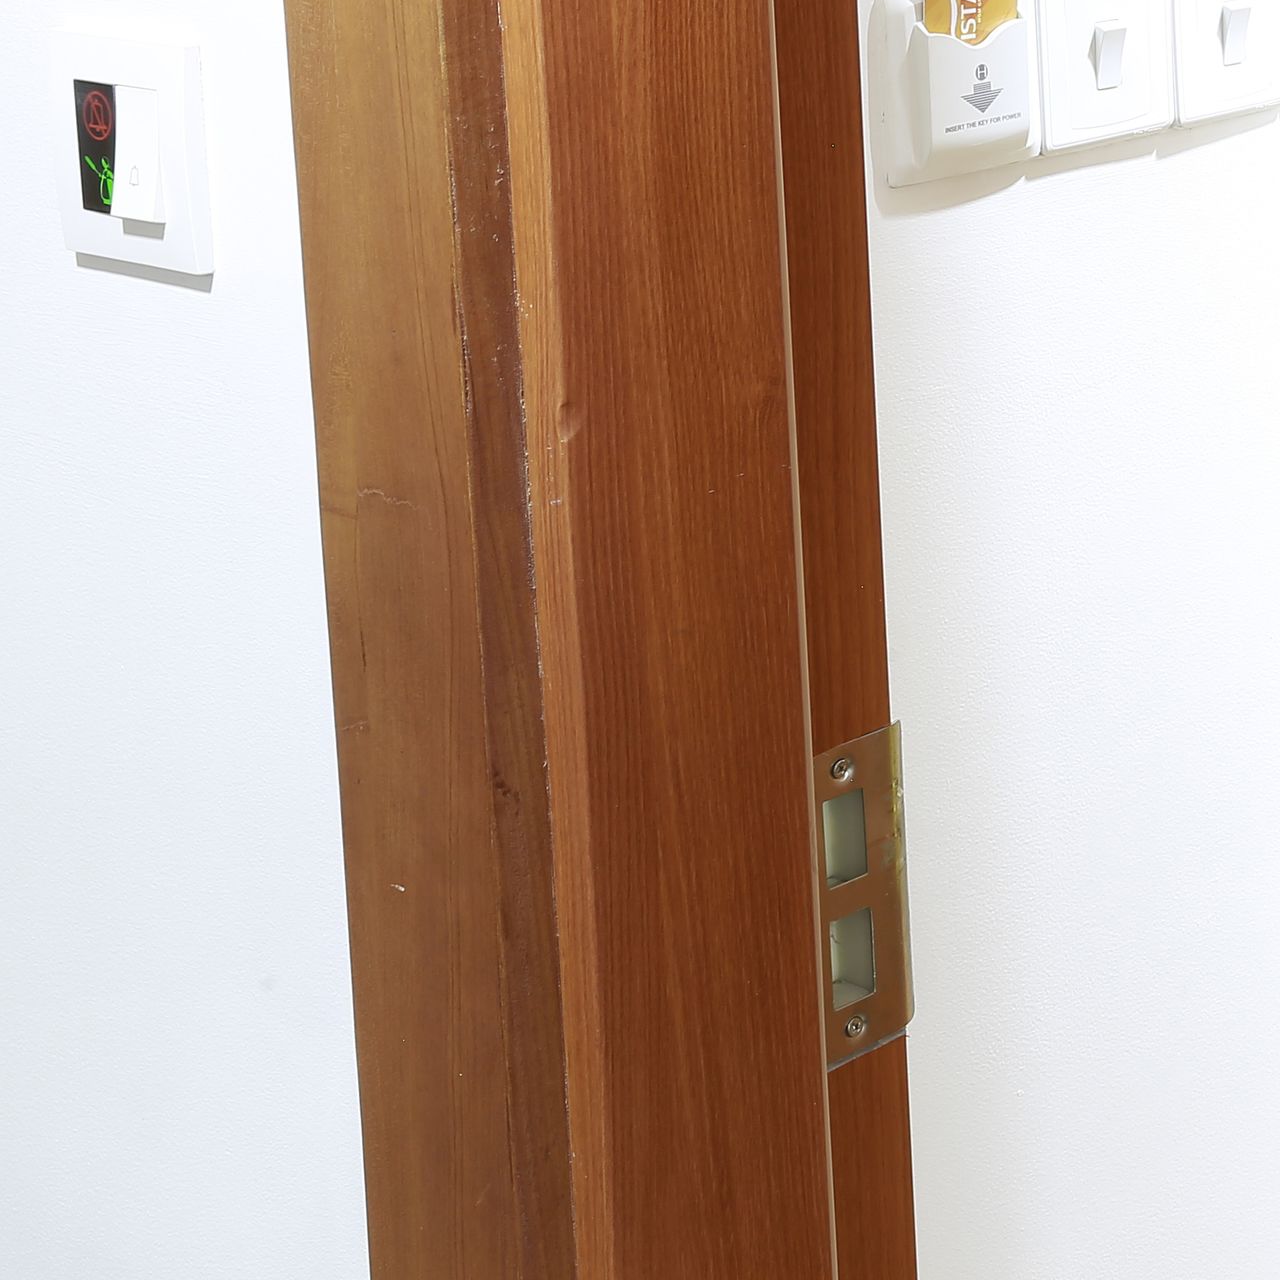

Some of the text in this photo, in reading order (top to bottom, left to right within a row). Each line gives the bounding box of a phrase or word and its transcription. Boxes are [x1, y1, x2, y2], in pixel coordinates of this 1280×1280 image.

[944, 112, 1021, 134] INSERT THE KEY FOR POWER
